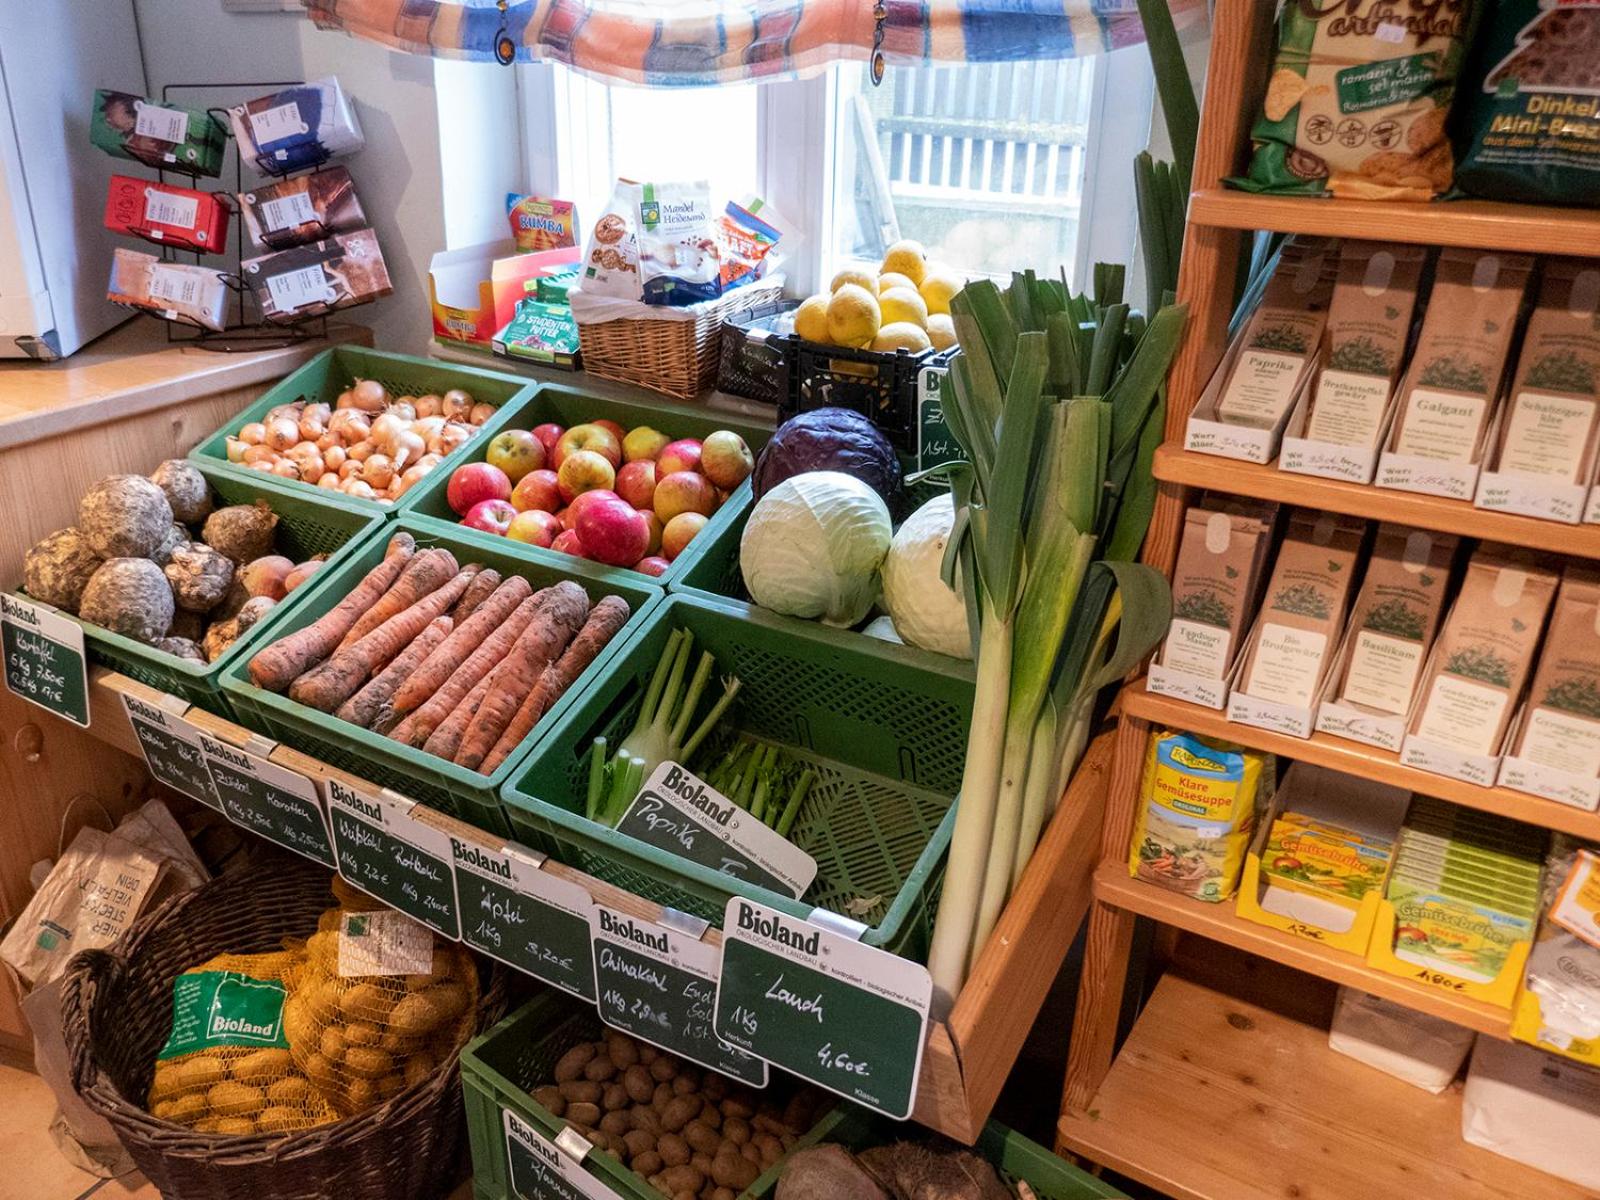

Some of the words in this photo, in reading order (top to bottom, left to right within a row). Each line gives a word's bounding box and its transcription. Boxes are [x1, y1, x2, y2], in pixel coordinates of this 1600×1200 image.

[1342, 67, 1393, 85] romarin
[1368, 78, 1389, 95] sel
[1391, 72, 1433, 88] marin
[1526, 95, 1597, 116] Dinkel
[663, 200, 694, 213] Mandel
[526, 315, 573, 331] STUDENTEN
[529, 325, 560, 338] FUTTER
[1249, 356, 1294, 371] Paprika
[1417, 399, 1474, 417] Galgant
[0, 595, 37, 625] Bioland
[1362, 639, 1416, 660] Basilikum
[199, 735, 252, 770] Bioland
[1156, 777, 1232, 808] Gemüsesuppe
[1179, 776, 1209, 792] Klare
[330, 781, 382, 823] Bioland
[662, 765, 736, 827] Bioland
[450, 837, 512, 880] Bioland
[1280, 839, 1369, 872] Gemüsebrühe
[79, 878, 133, 907] VIELFALT
[115, 873, 141, 892] DRIN
[92, 922, 121, 939] HIER
[599, 909, 669, 954] Bioland
[737, 902, 820, 956] Bioland
[1400, 903, 1506, 943] Gemüsebrühe
[765, 973, 823, 1023] Lauch
[212, 1016, 274, 1036] Bioland
[725, 1030, 753, 1049] Herkunft
[855, 1087, 880, 1105] Klasse
[508, 1114, 560, 1168] Bioland
